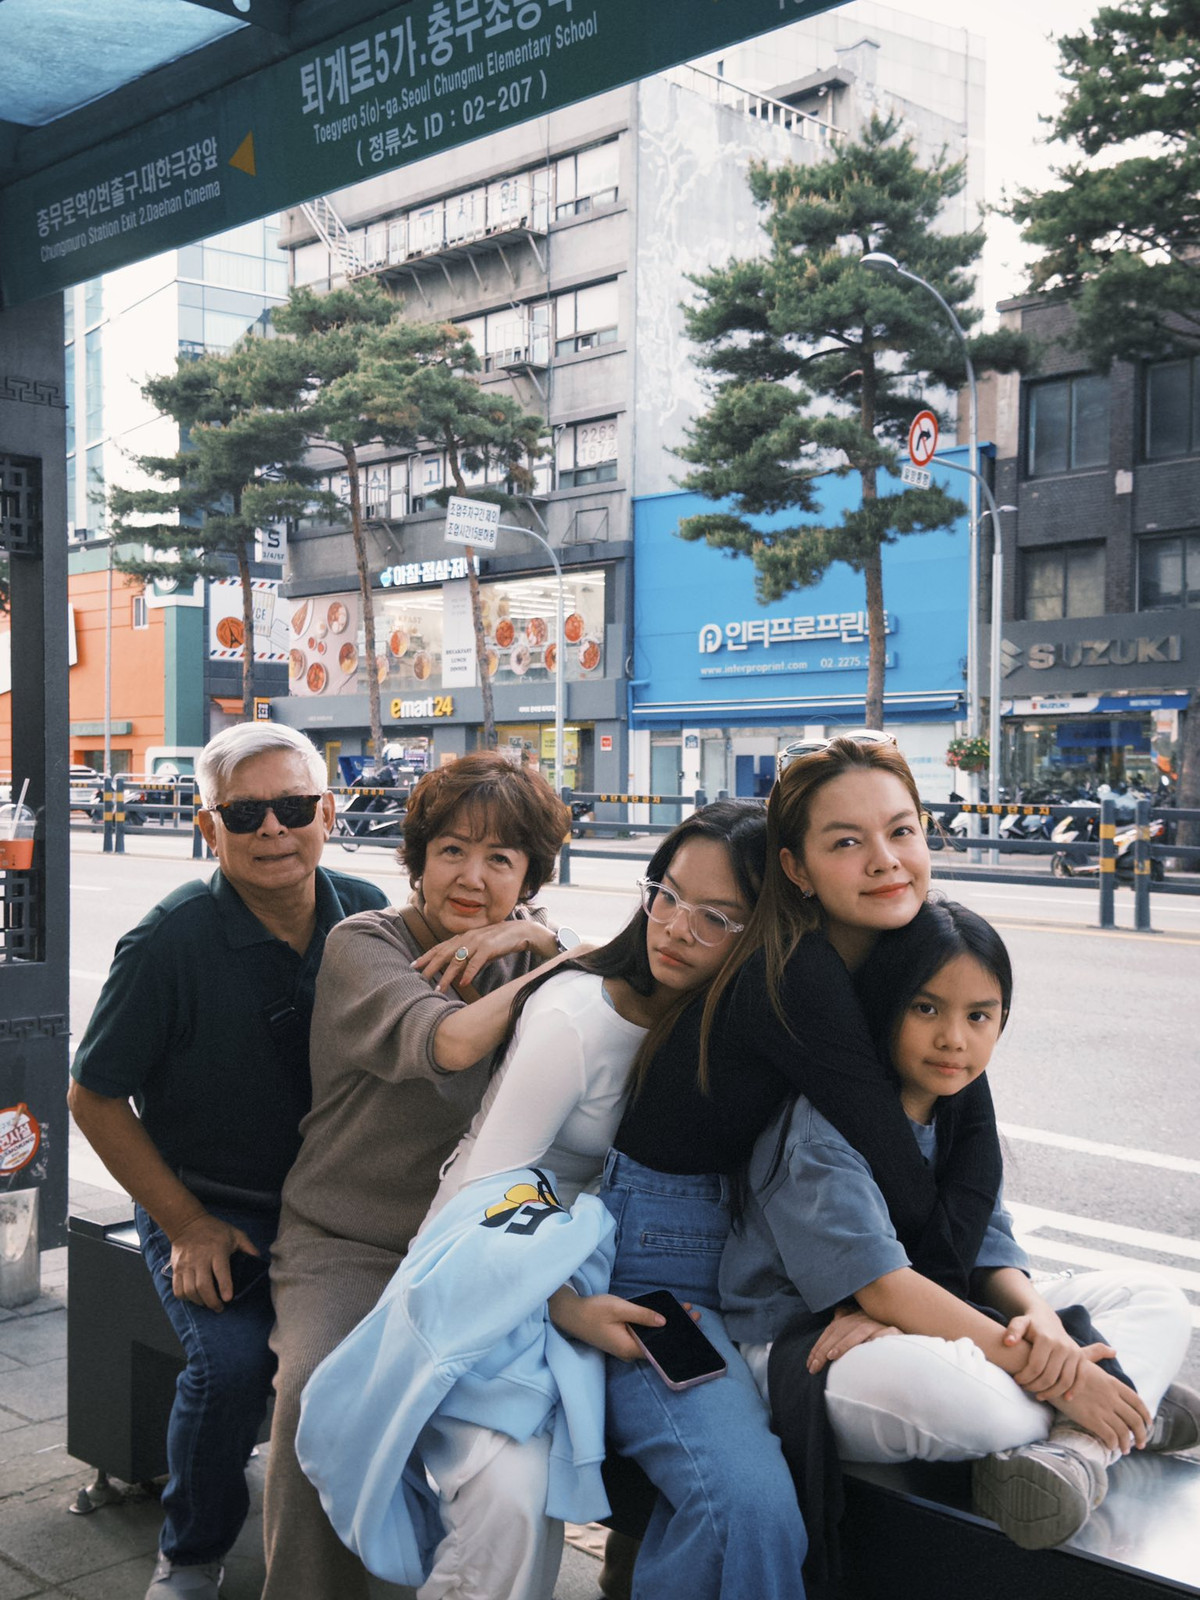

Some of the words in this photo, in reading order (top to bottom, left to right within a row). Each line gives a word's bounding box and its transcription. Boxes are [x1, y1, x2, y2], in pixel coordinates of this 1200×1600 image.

[313, 115, 358, 145] Toegyero
[433, 61, 485, 98] Chungmu
[487, 34, 552, 77] Elementary
[555, 10, 598, 50] School
[368, 123, 419, 163] 정류소
[424, 112, 443, 140] ID
[462, 77, 532, 126] 02-207
[40, 232, 87, 263] Chungmuro
[88, 220, 120, 245] Station
[121, 212, 137, 232] Exit
[184, 180, 221, 208] Cinema
[1028, 635, 1181, 670] SUZUKI
[390, 695, 454, 719] emart24
